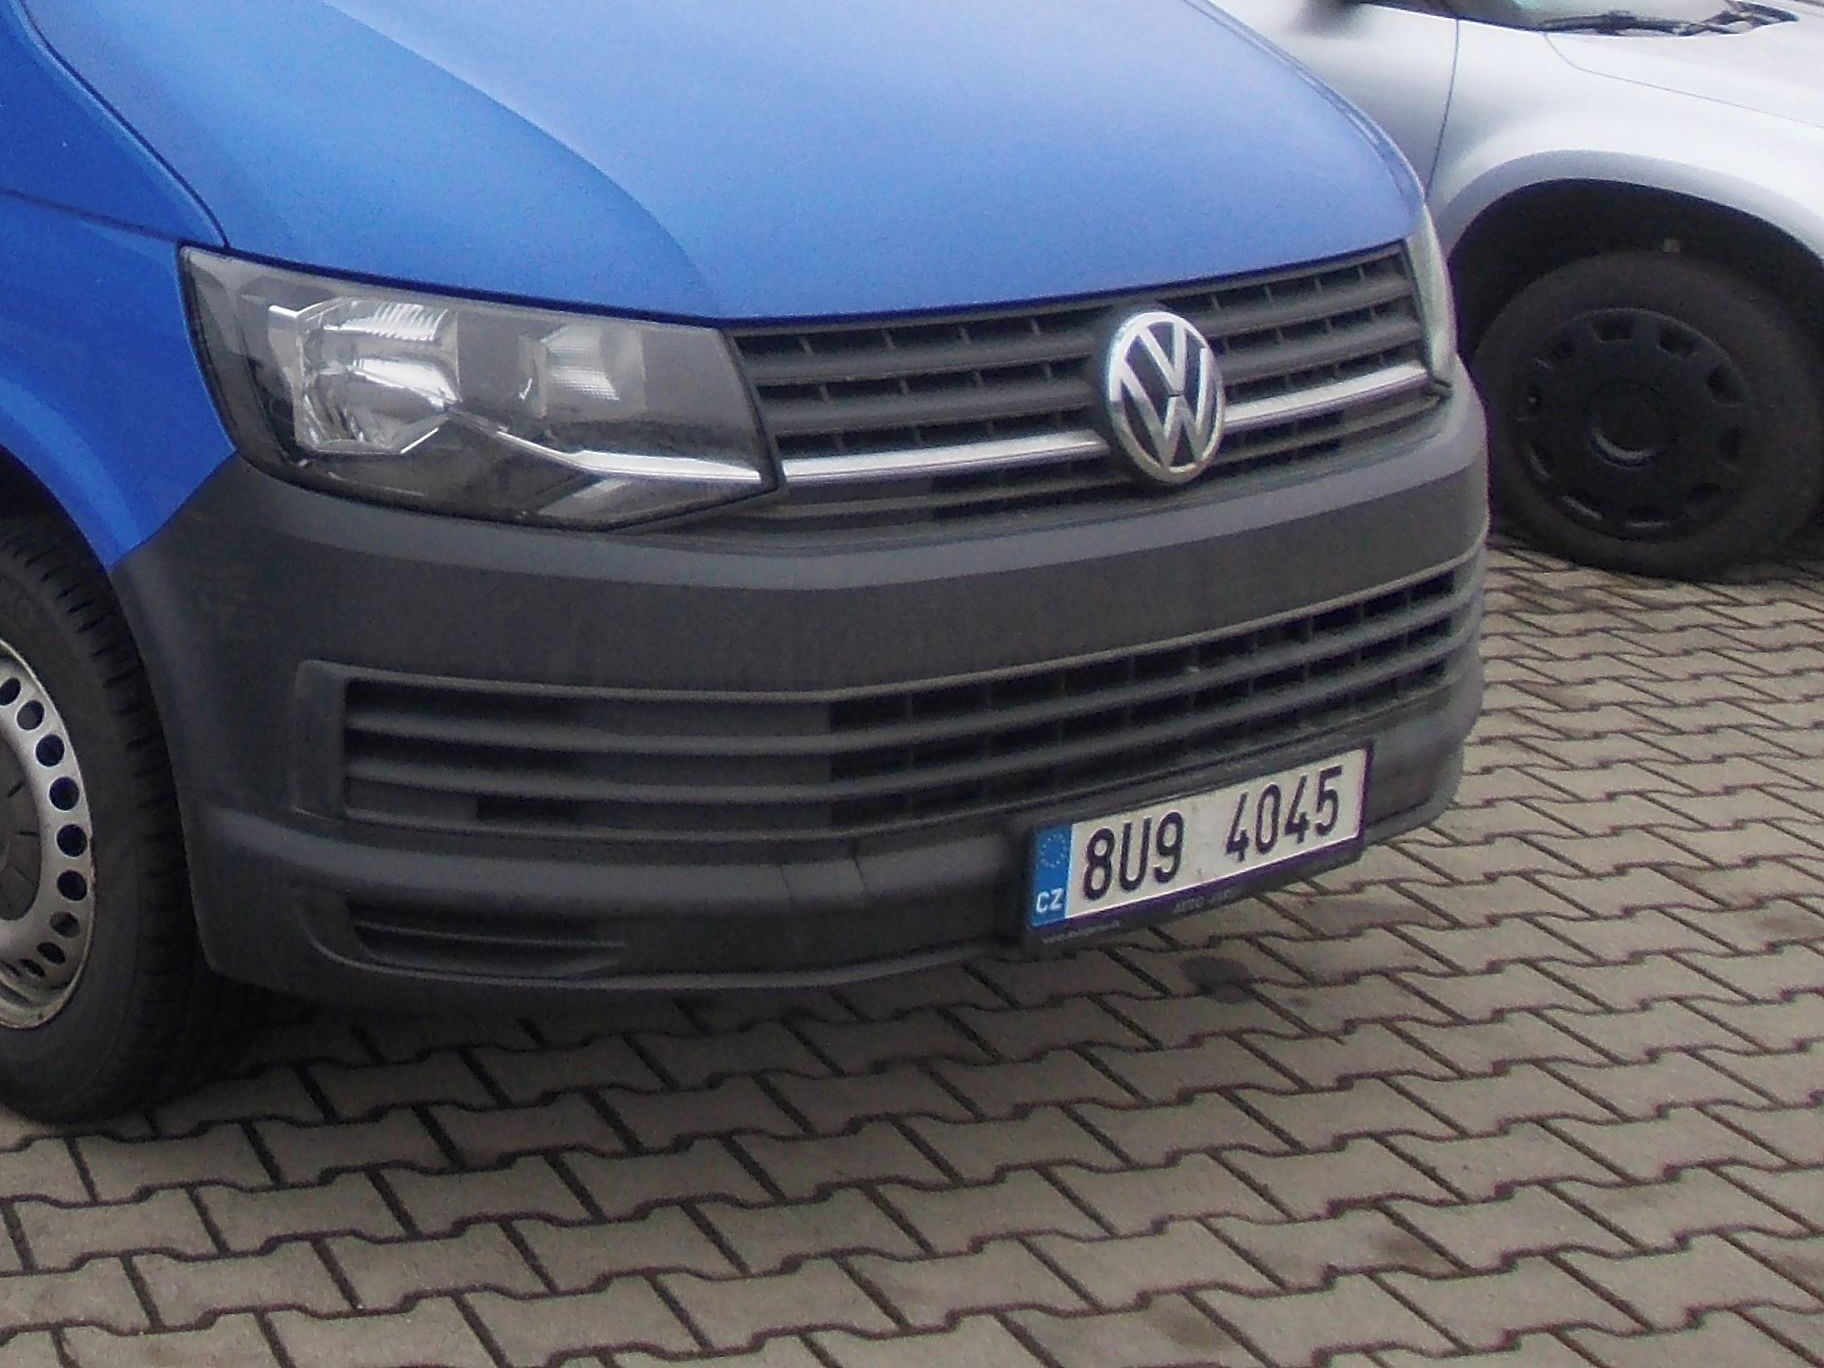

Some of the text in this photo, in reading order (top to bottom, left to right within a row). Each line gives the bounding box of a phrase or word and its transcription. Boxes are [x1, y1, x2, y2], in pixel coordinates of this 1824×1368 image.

[1082, 765, 1343, 901] 8U9 4045
[1035, 887, 1065, 914] CZ
